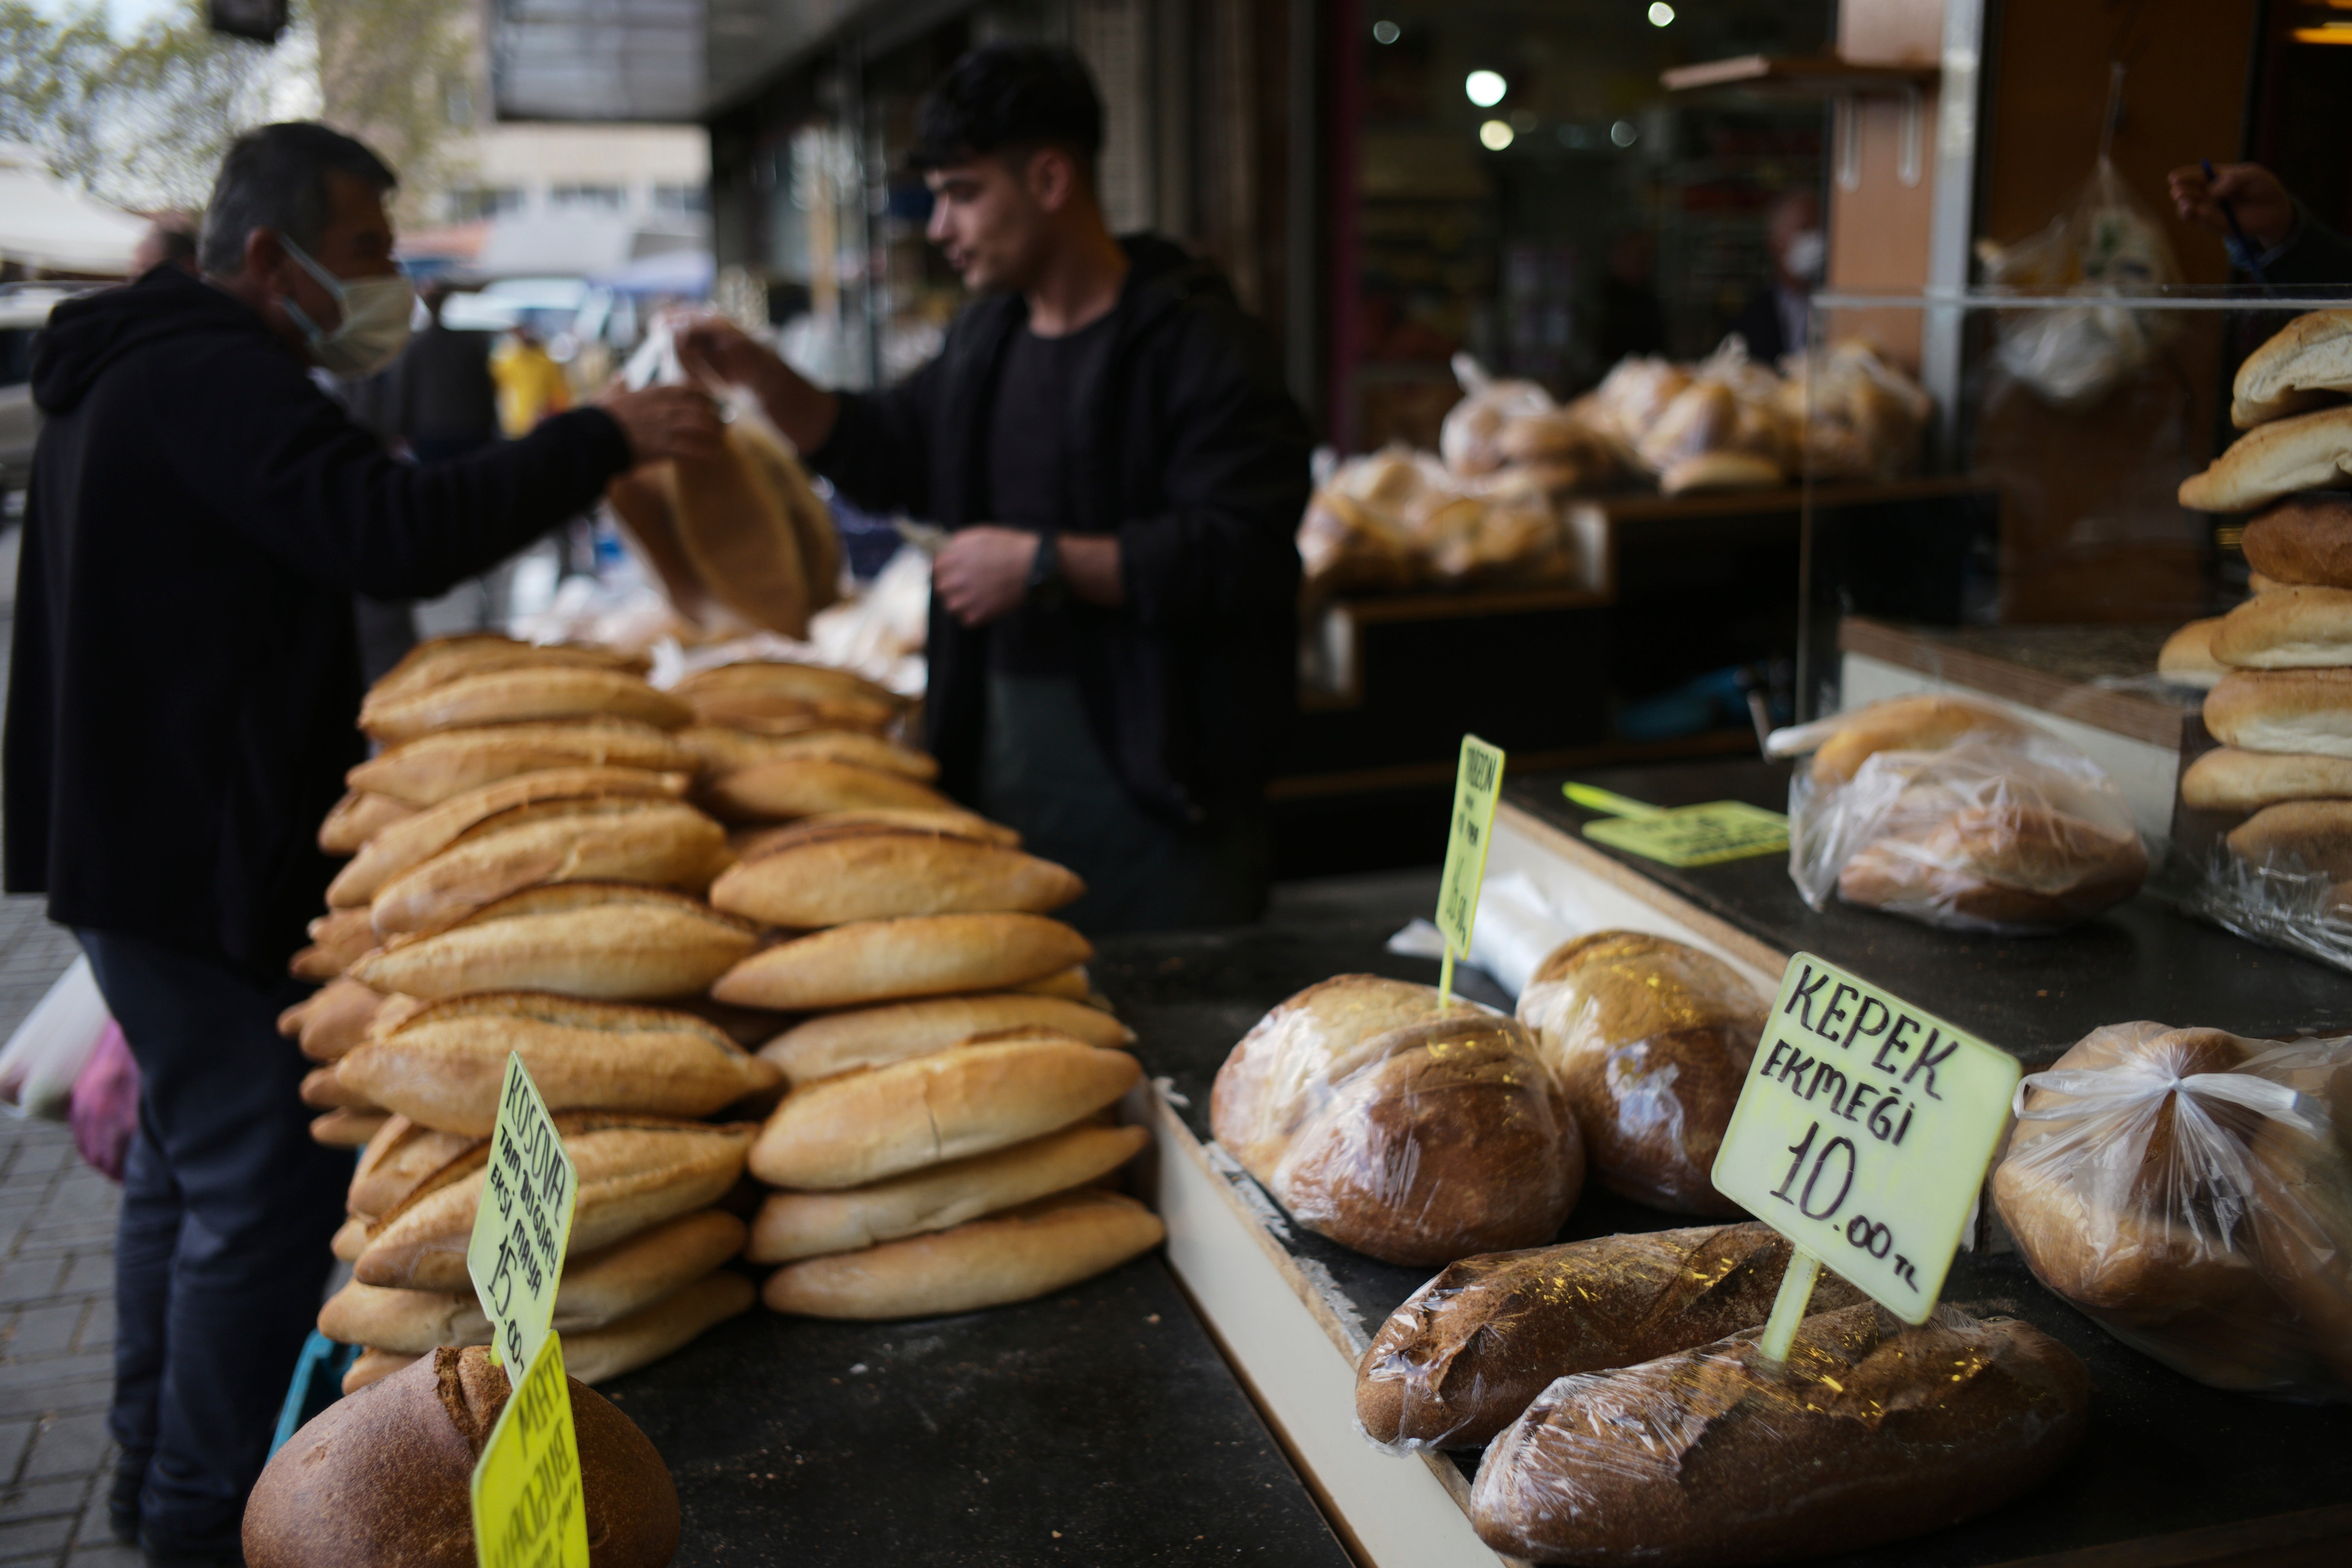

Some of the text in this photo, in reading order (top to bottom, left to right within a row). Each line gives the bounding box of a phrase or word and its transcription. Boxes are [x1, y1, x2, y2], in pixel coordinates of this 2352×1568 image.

[1760, 1038, 1915, 1146] EKMEĞİ
[1784, 965, 1959, 1101] KEPEK
[500, 1124, 558, 1278] TAM BUĞDAY
[506, 1063, 566, 1228] KOSOVA
[512, 1218, 542, 1300] MAYA
